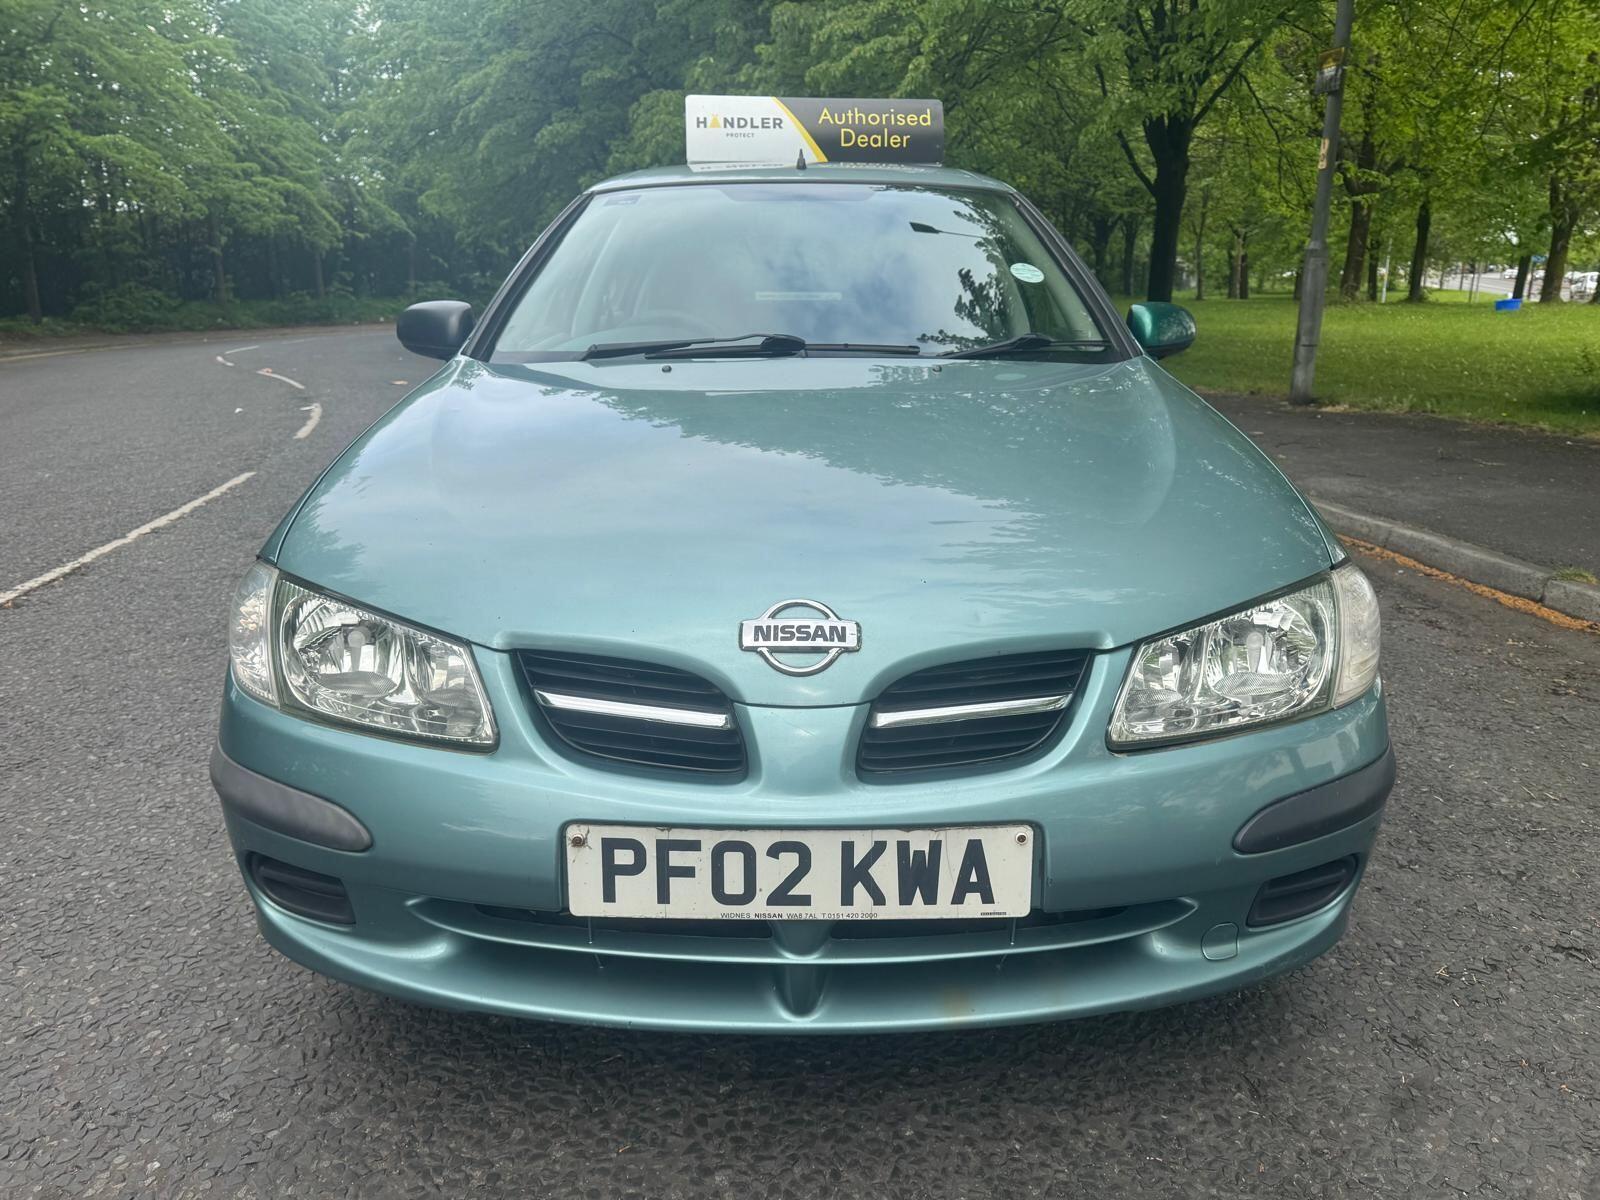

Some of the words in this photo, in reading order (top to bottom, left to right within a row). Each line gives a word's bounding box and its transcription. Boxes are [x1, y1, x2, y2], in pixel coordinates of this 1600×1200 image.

[818, 107, 931, 126] Authorised
[840, 127, 911, 148] Dealer
[753, 624, 847, 643] NISSAN
[600, 837, 812, 906] PF02
[840, 838, 996, 906] KWA
